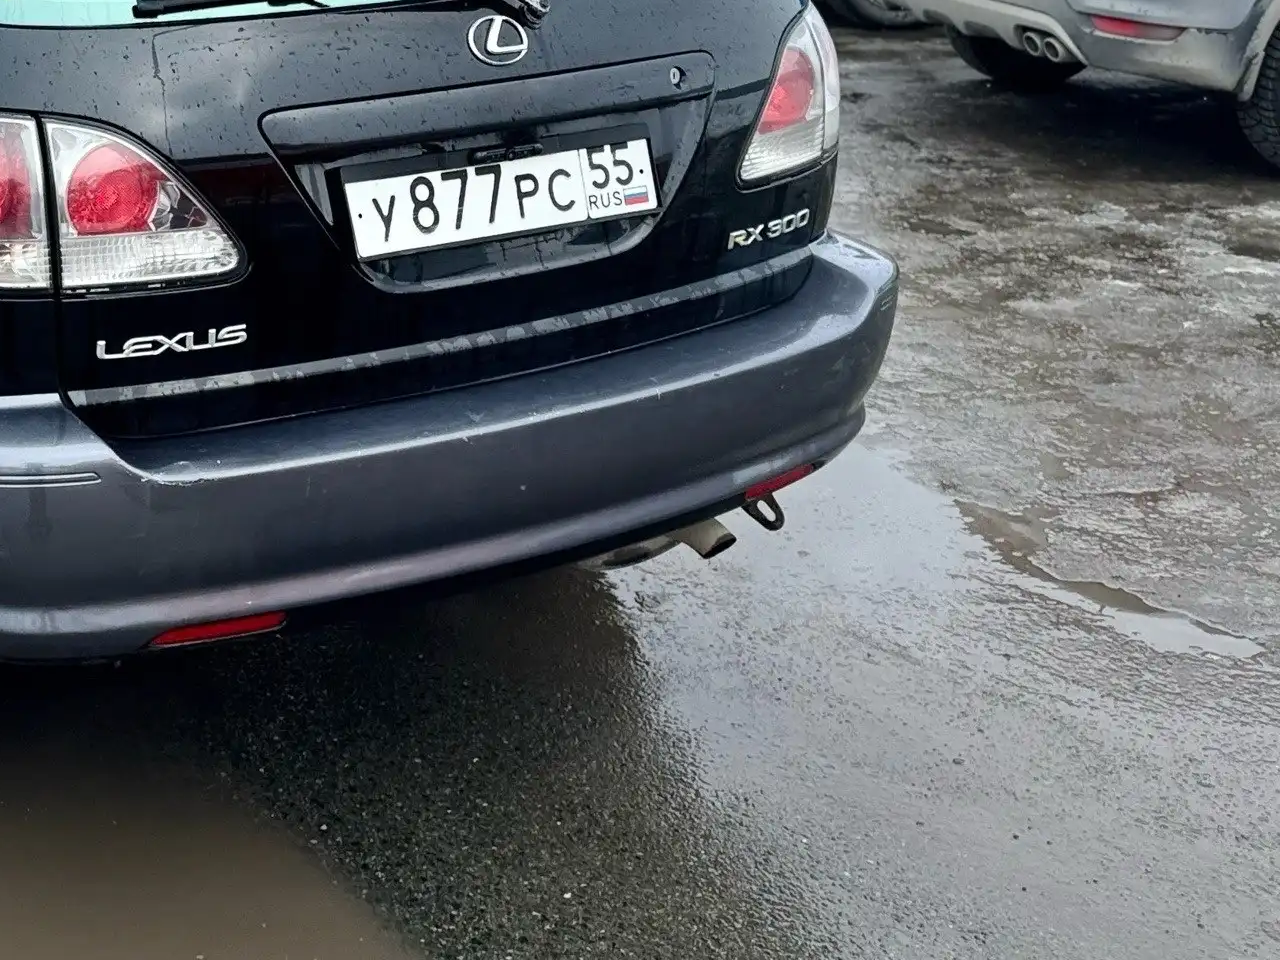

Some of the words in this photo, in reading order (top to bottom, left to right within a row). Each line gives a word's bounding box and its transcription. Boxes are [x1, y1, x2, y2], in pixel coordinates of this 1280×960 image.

[371, 163, 576, 243] У877РС
[585, 141, 634, 190] 55
[588, 190, 623, 211] RUS
[726, 223, 765, 251] RX
[765, 207, 811, 239] 300
[95, 323, 248, 360] LEXUS
